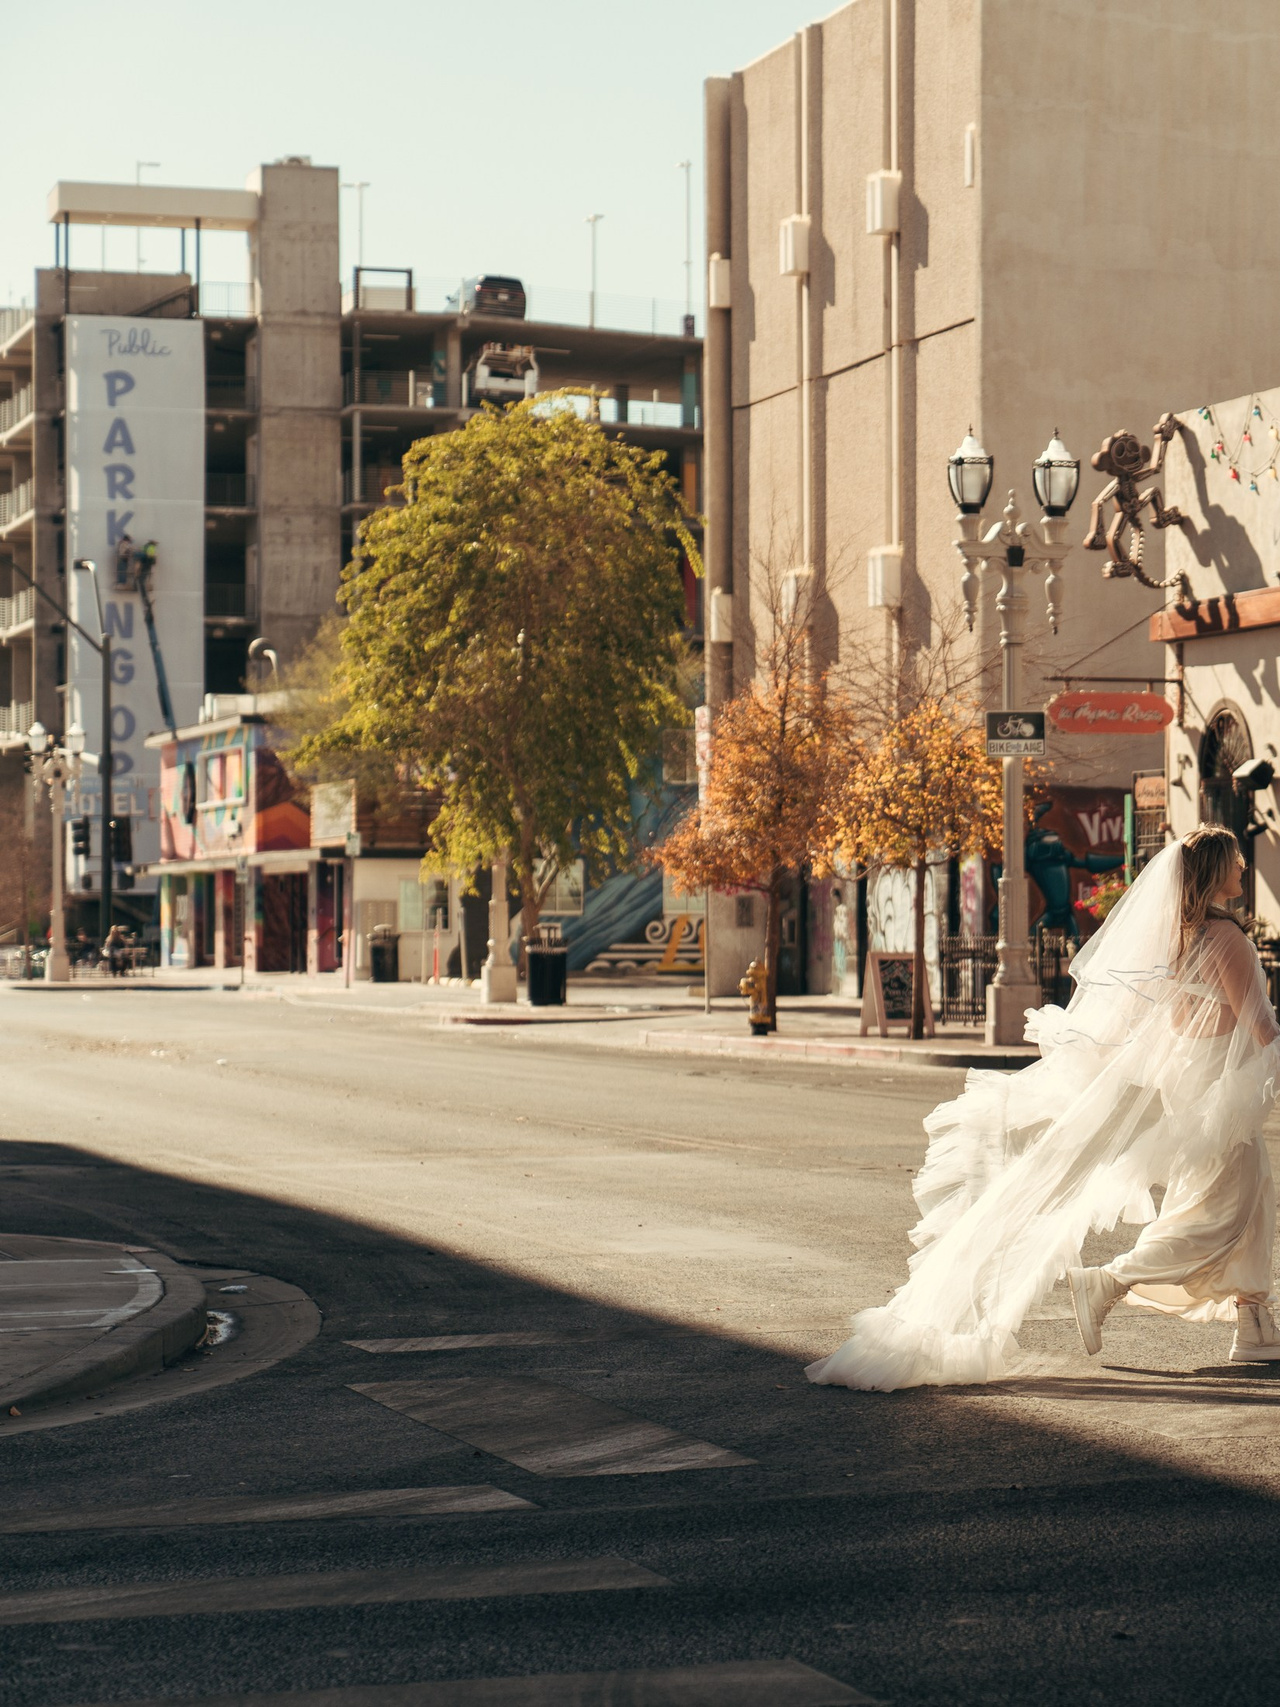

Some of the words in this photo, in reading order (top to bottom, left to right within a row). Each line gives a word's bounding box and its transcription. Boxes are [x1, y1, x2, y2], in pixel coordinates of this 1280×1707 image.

[101, 328, 171, 356] Public
[103, 369, 136, 684] PARKNG
[989, 741, 1012, 754] BIKE
[1017, 741, 1043, 754] LANE
[63, 792, 144, 816] HOEL
